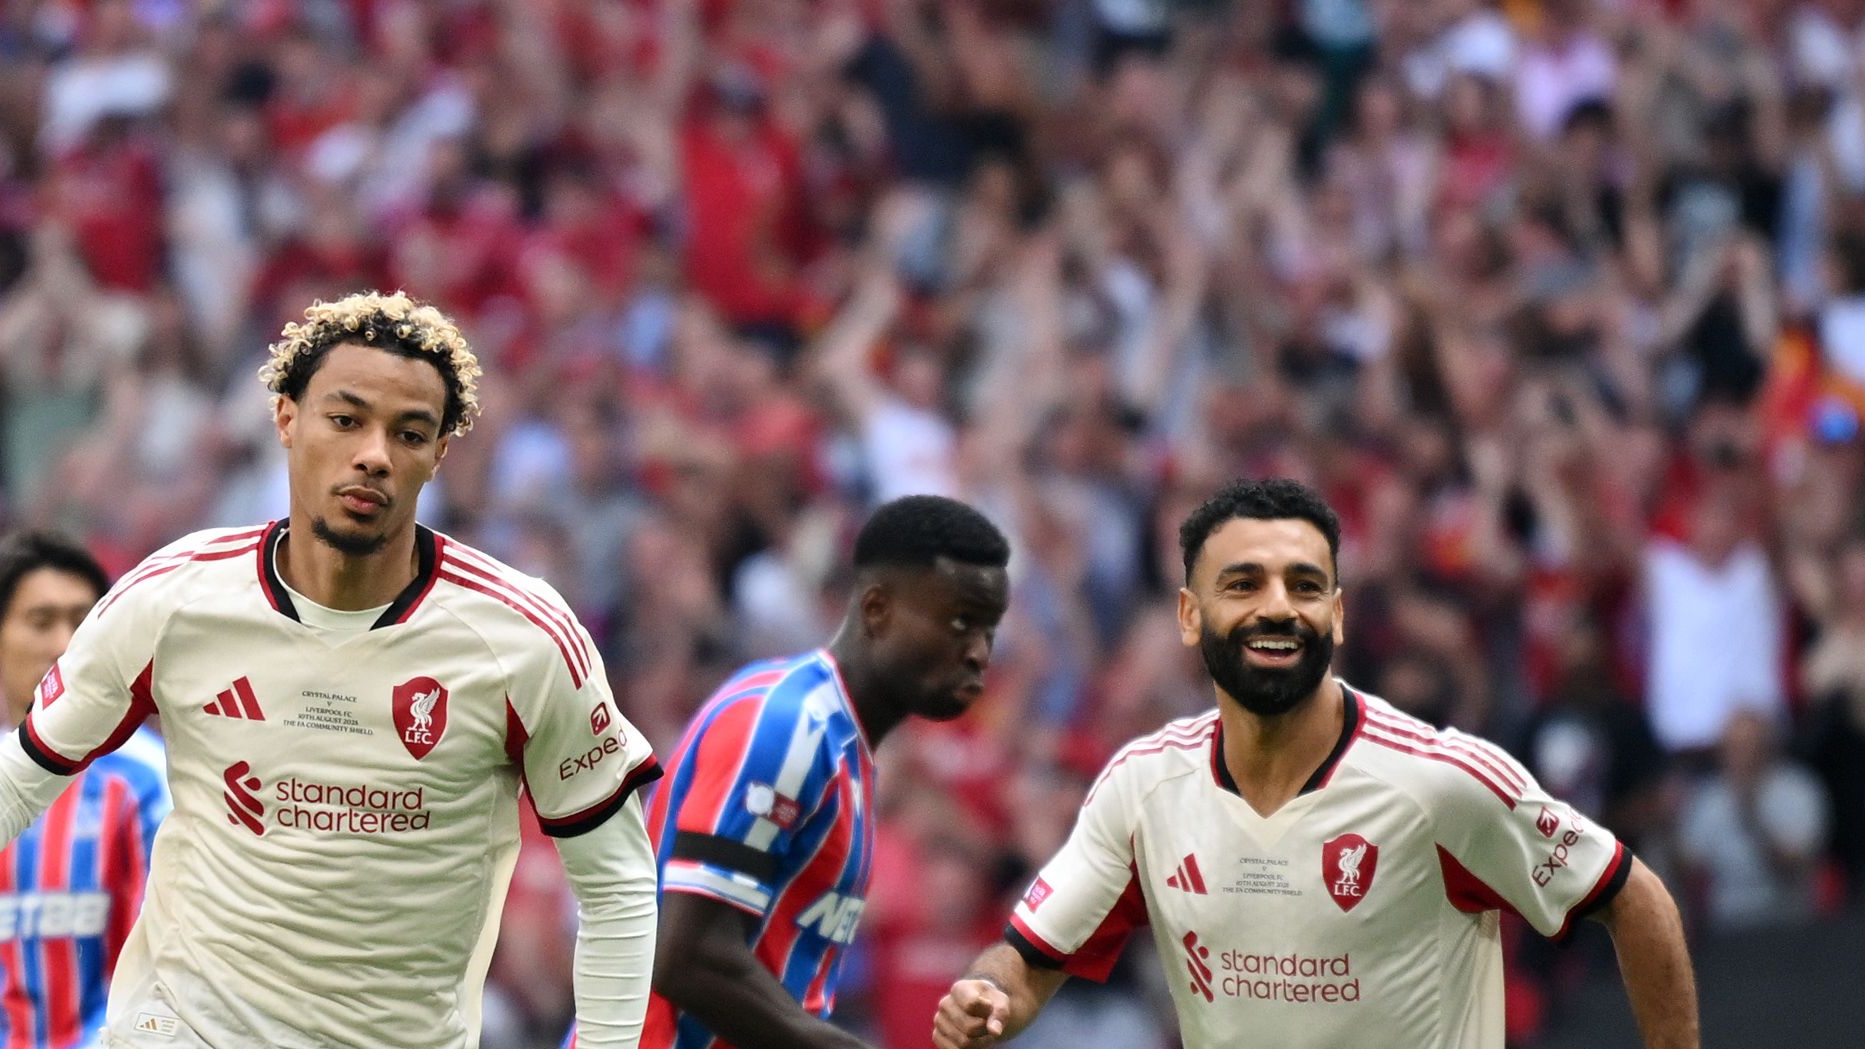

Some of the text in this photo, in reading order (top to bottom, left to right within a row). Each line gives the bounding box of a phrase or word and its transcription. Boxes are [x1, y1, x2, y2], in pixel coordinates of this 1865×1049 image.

[302, 690, 357, 703] CRYSTAL PALACE
[305, 707, 342, 717] LIVERPOOL
[316, 715, 343, 724] AUGUST
[306, 722, 348, 733] COMMUNITY
[349, 727, 374, 736] SHIELD
[276, 777, 423, 810] standard
[277, 804, 430, 833] chartered
[1221, 949, 1349, 977] standard
[1223, 974, 1360, 1003] chartered
